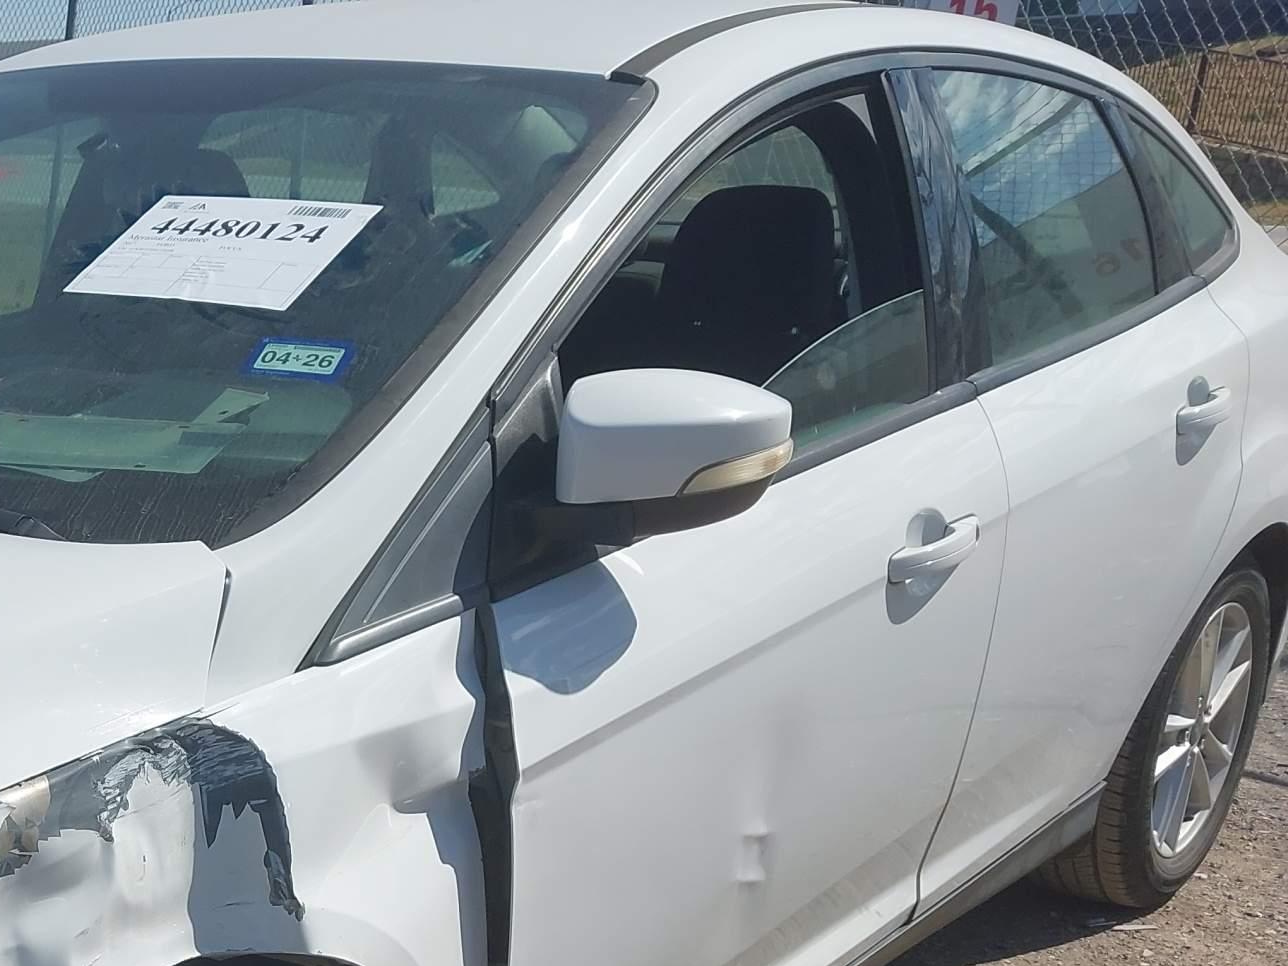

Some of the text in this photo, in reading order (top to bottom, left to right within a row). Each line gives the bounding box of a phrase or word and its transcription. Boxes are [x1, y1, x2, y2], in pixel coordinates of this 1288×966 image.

[151, 216, 328, 243] 44480124
[260, 350, 335, 369] 04 26
